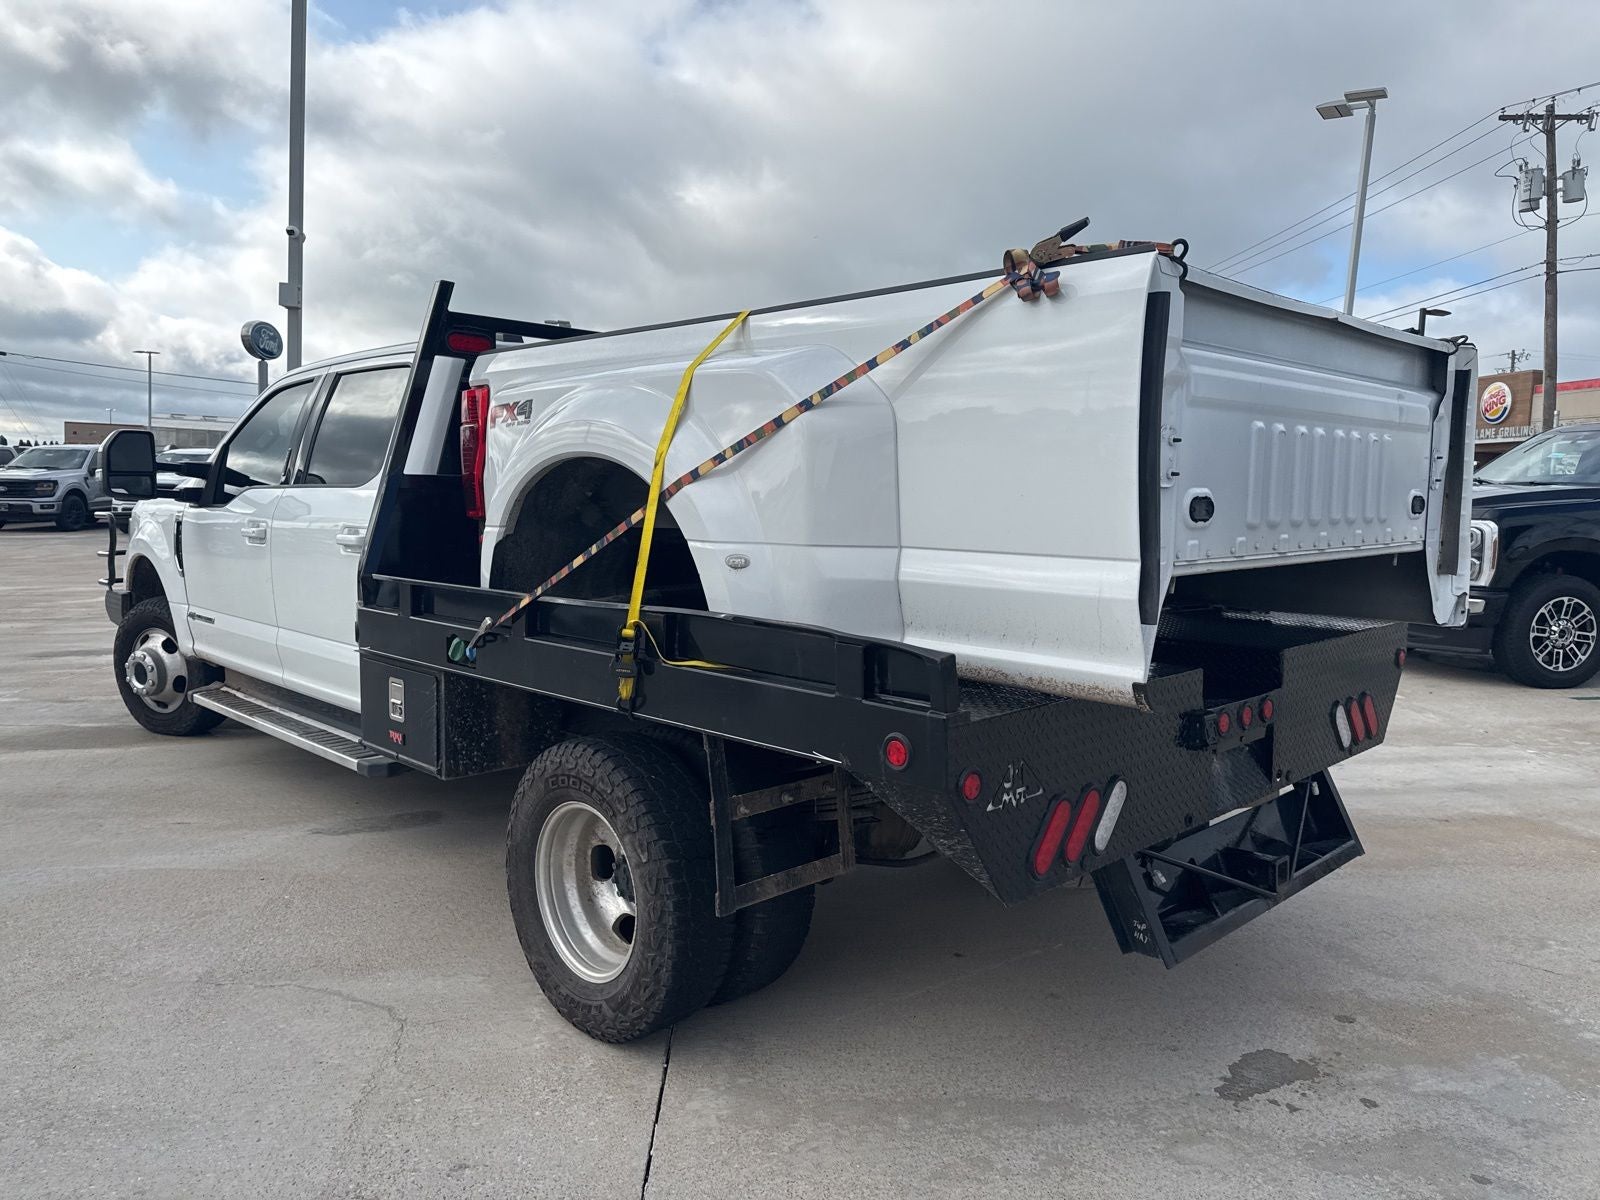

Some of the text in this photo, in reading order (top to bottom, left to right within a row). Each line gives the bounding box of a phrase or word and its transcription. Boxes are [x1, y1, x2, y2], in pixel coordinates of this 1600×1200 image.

[259, 328, 279, 353] Ford
[490, 399, 533, 429] FX4
[1484, 395, 1507, 415] KING
[1475, 425, 1536, 439] LAME GRILLING
[549, 776, 615, 818] COOPER
